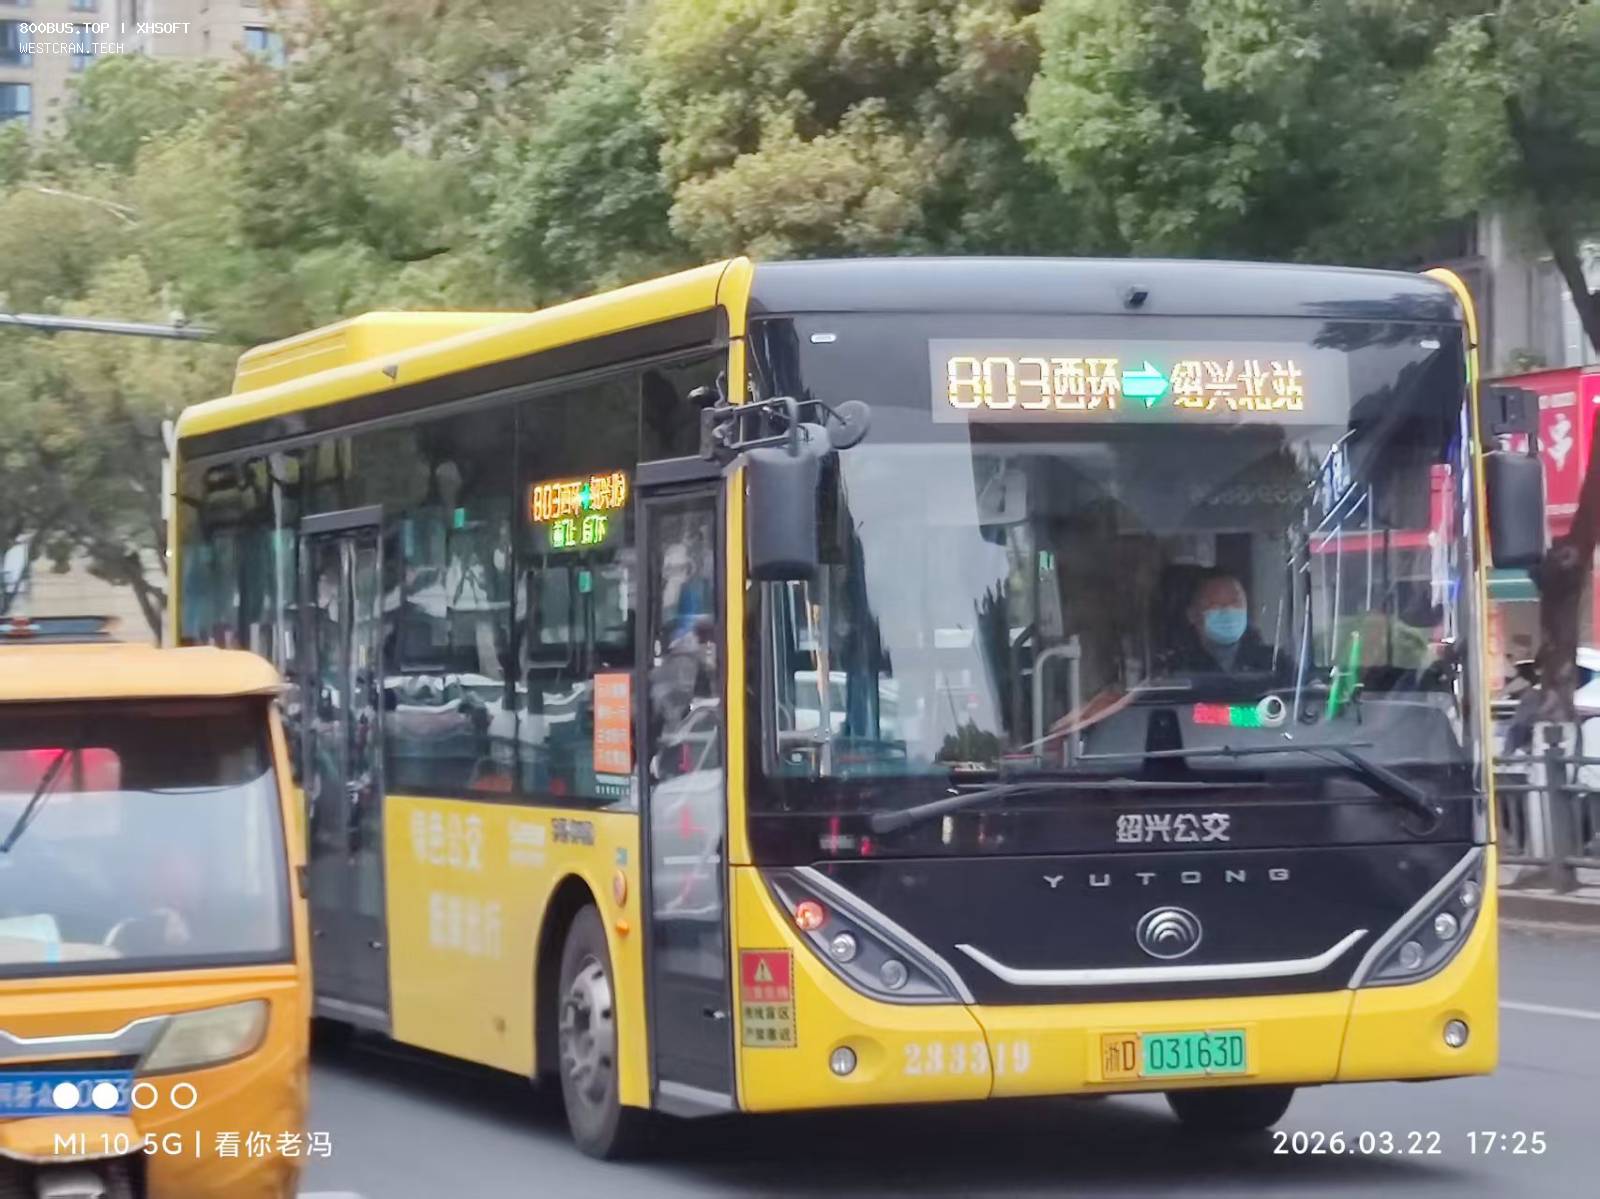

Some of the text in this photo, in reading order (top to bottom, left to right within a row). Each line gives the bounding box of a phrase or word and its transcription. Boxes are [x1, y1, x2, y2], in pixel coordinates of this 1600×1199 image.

[1170, 359, 1304, 411] 绍兴北站
[1116, 812, 1231, 843] 绍兴公交
[1043, 868, 1290, 888] YUTONG
[1150, 1035, 1244, 1070] 03163D
